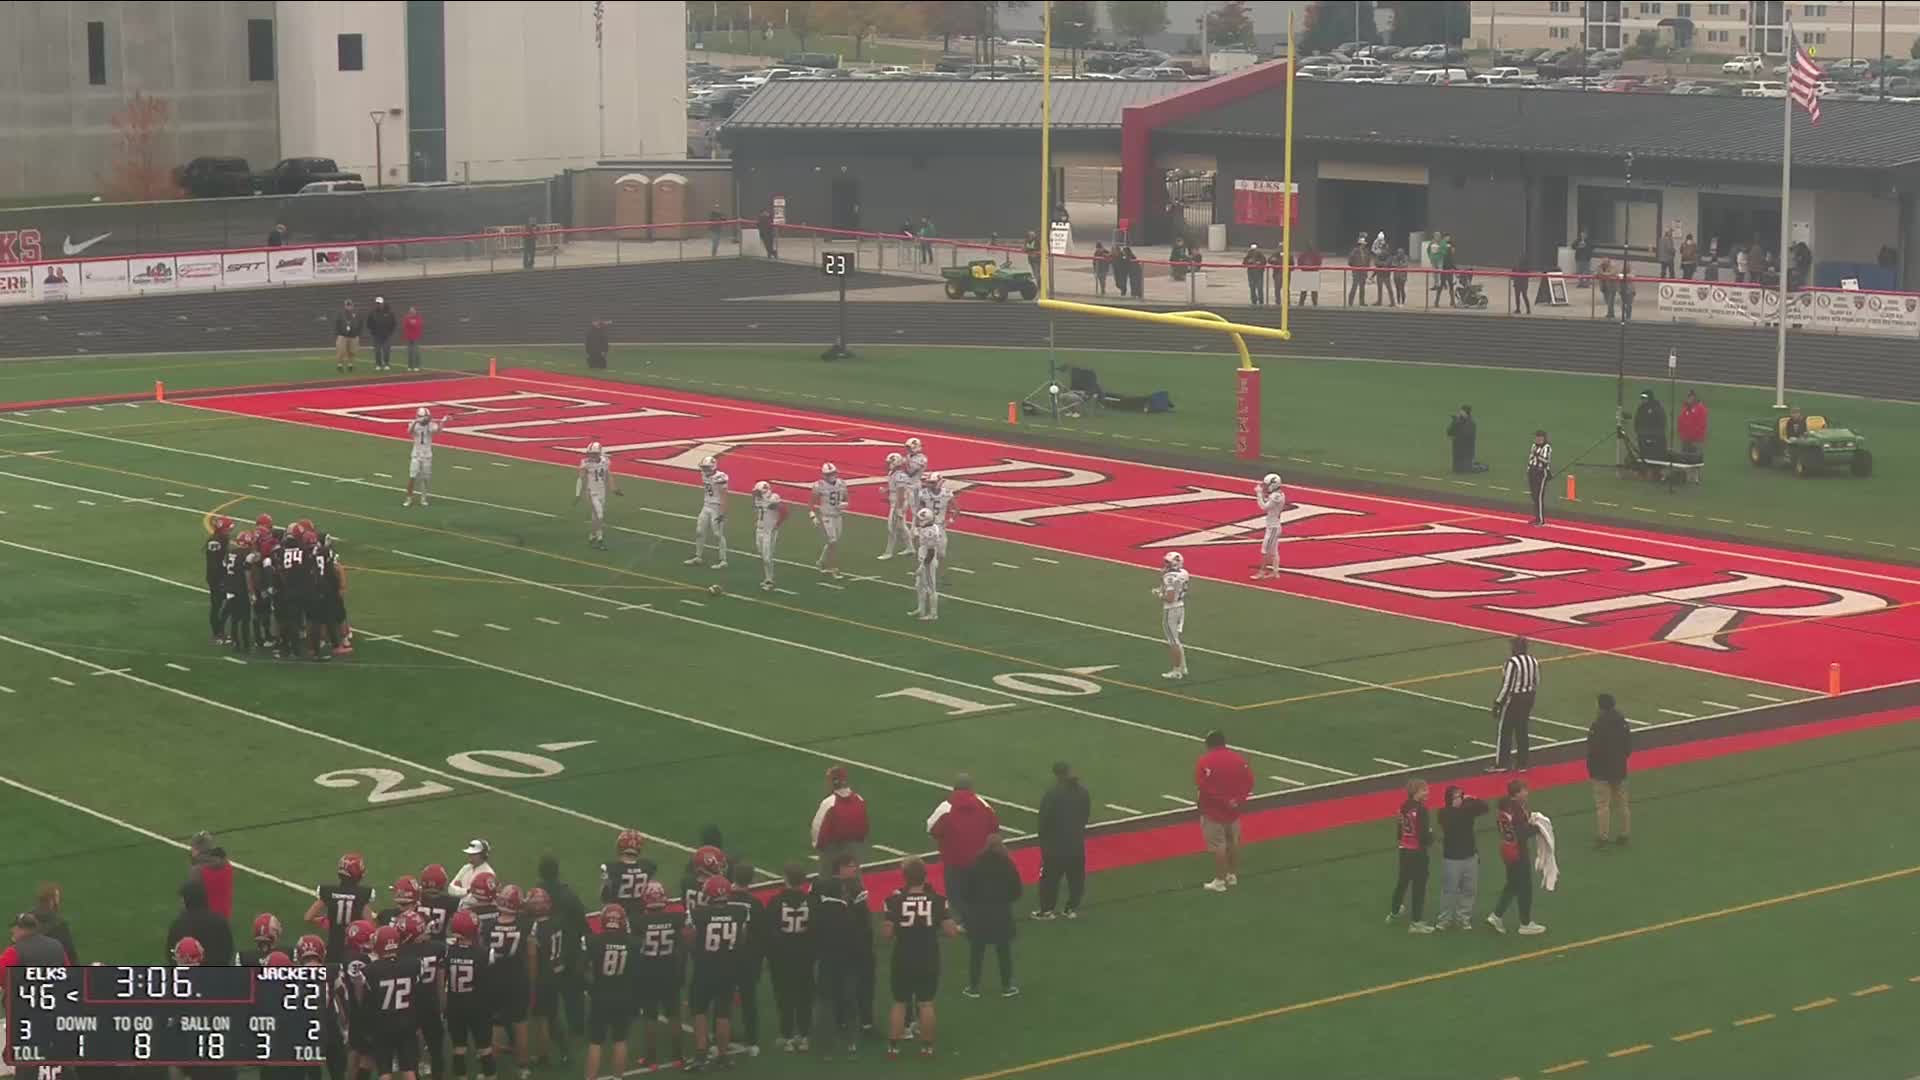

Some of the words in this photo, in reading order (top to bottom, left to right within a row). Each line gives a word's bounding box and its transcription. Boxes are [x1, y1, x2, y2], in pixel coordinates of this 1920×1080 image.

[1253, 182, 1280, 190] ELKS
[826, 255, 845, 274] 23
[297, 390, 912, 468] ELK
[770, 457, 1899, 654] RIVER
[284, 550, 303, 568] 84
[875, 673, 1102, 715] 10
[313, 750, 566, 803] 20
[618, 873, 649, 899] 22
[336, 900, 354, 926] 11
[780, 904, 810, 934] 52
[901, 900, 933, 928] 54
[490, 931, 521, 958] 27
[642, 929, 676, 957] 55
[705, 922, 738, 952] 64
[602, 951, 629, 976] 81
[450, 965, 474, 993] 12
[379, 977, 412, 1010] 72
